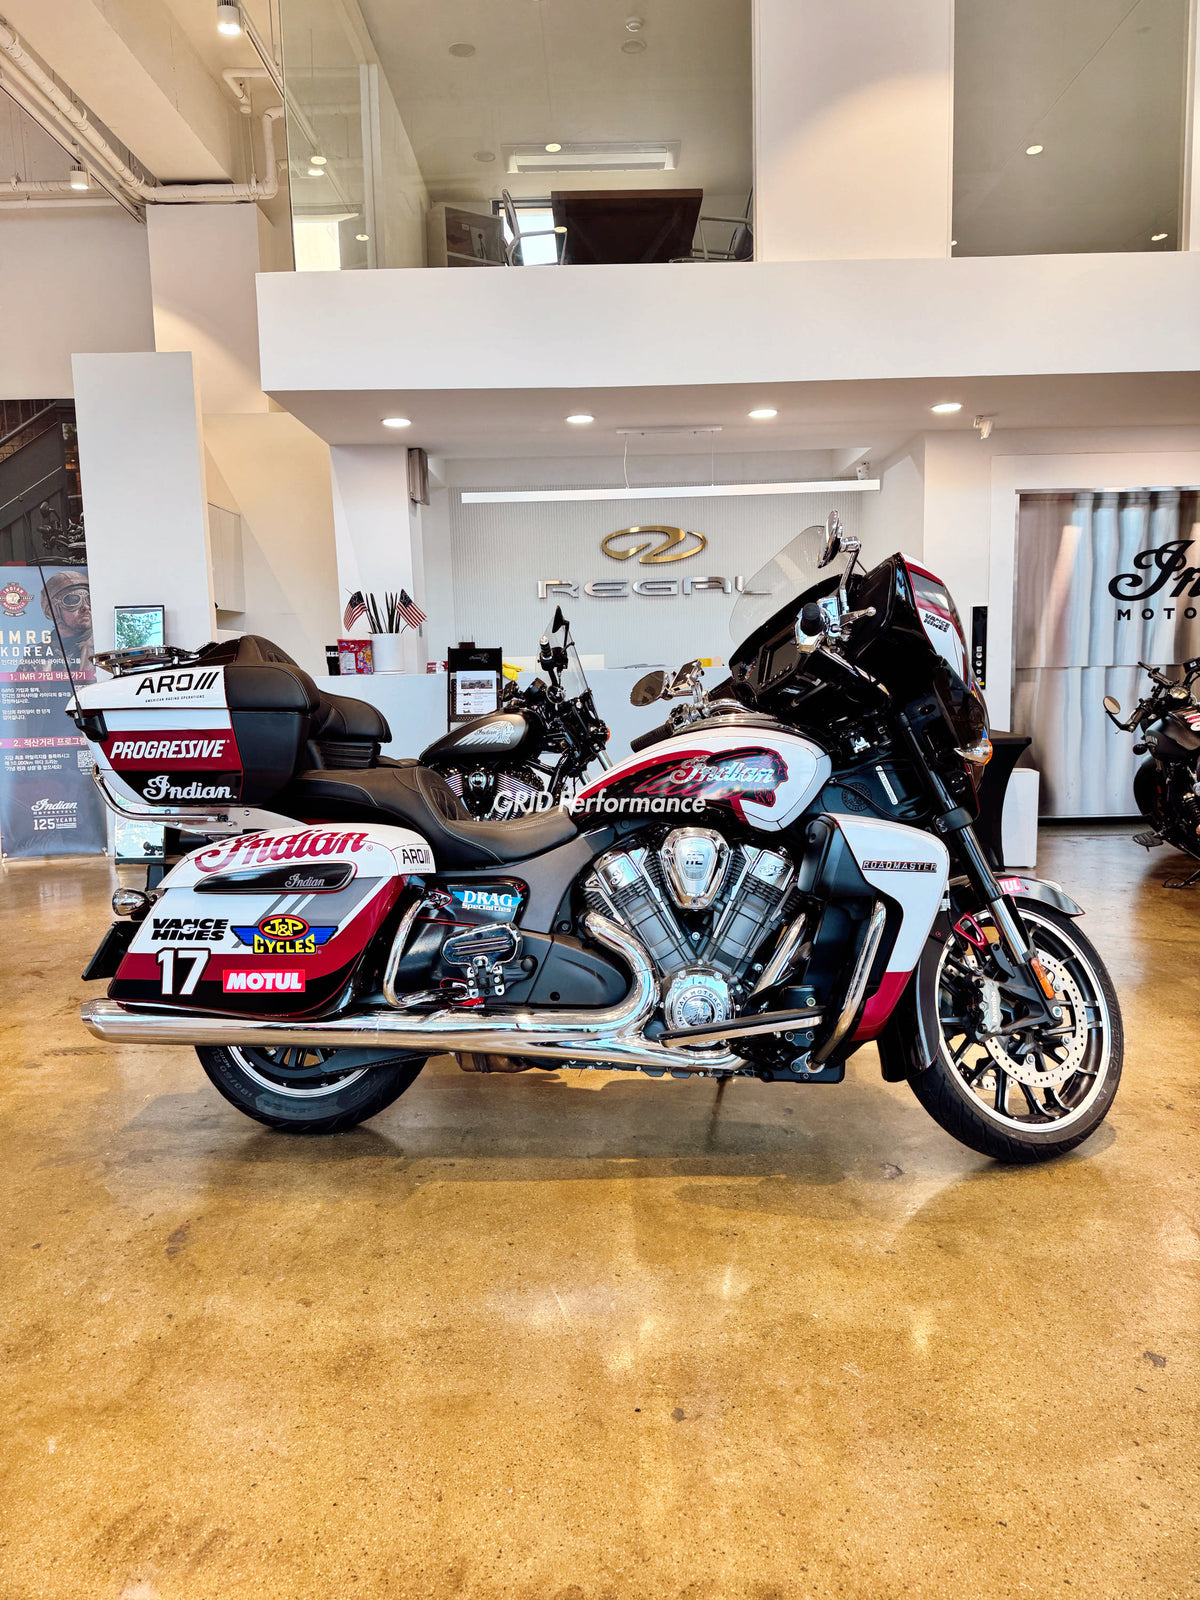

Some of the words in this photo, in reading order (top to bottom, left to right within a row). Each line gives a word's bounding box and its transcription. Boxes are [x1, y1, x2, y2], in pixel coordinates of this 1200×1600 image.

[537, 576, 772, 599] REGAL
[0, 630, 52, 644] IMRG
[1, 646, 54, 657] KOREA
[20, 673, 36, 681] IMR
[37, 672, 53, 681] 가입
[55, 671, 86, 680] 바로가기
[13, 740, 21, 748] 2.
[24, 738, 54, 747] 적산거리
[110, 739, 226, 759] PROGRESSIVE
[670, 754, 776, 785] Indian
[31, 798, 78, 811] Indian
[33, 818, 56, 830] 125
[194, 829, 369, 872] Indian
[863, 861, 937, 871] ROADMASTER
[285, 874, 325, 888] Indian
[463, 890, 513, 907] DRAG
[461, 903, 512, 913] Specialties
[153, 919, 229, 929] VANCE
[264, 918, 304, 937] J&P
[151, 930, 226, 941] HINES
[253, 934, 316, 954] CYCLES
[157, 949, 209, 996] 17
[226, 973, 302, 990] MOTUL
[676, 995, 689, 1027] INDIAN
[690, 989, 723, 1023] MOTORCYC
[990, 990, 998, 1023] brembo
